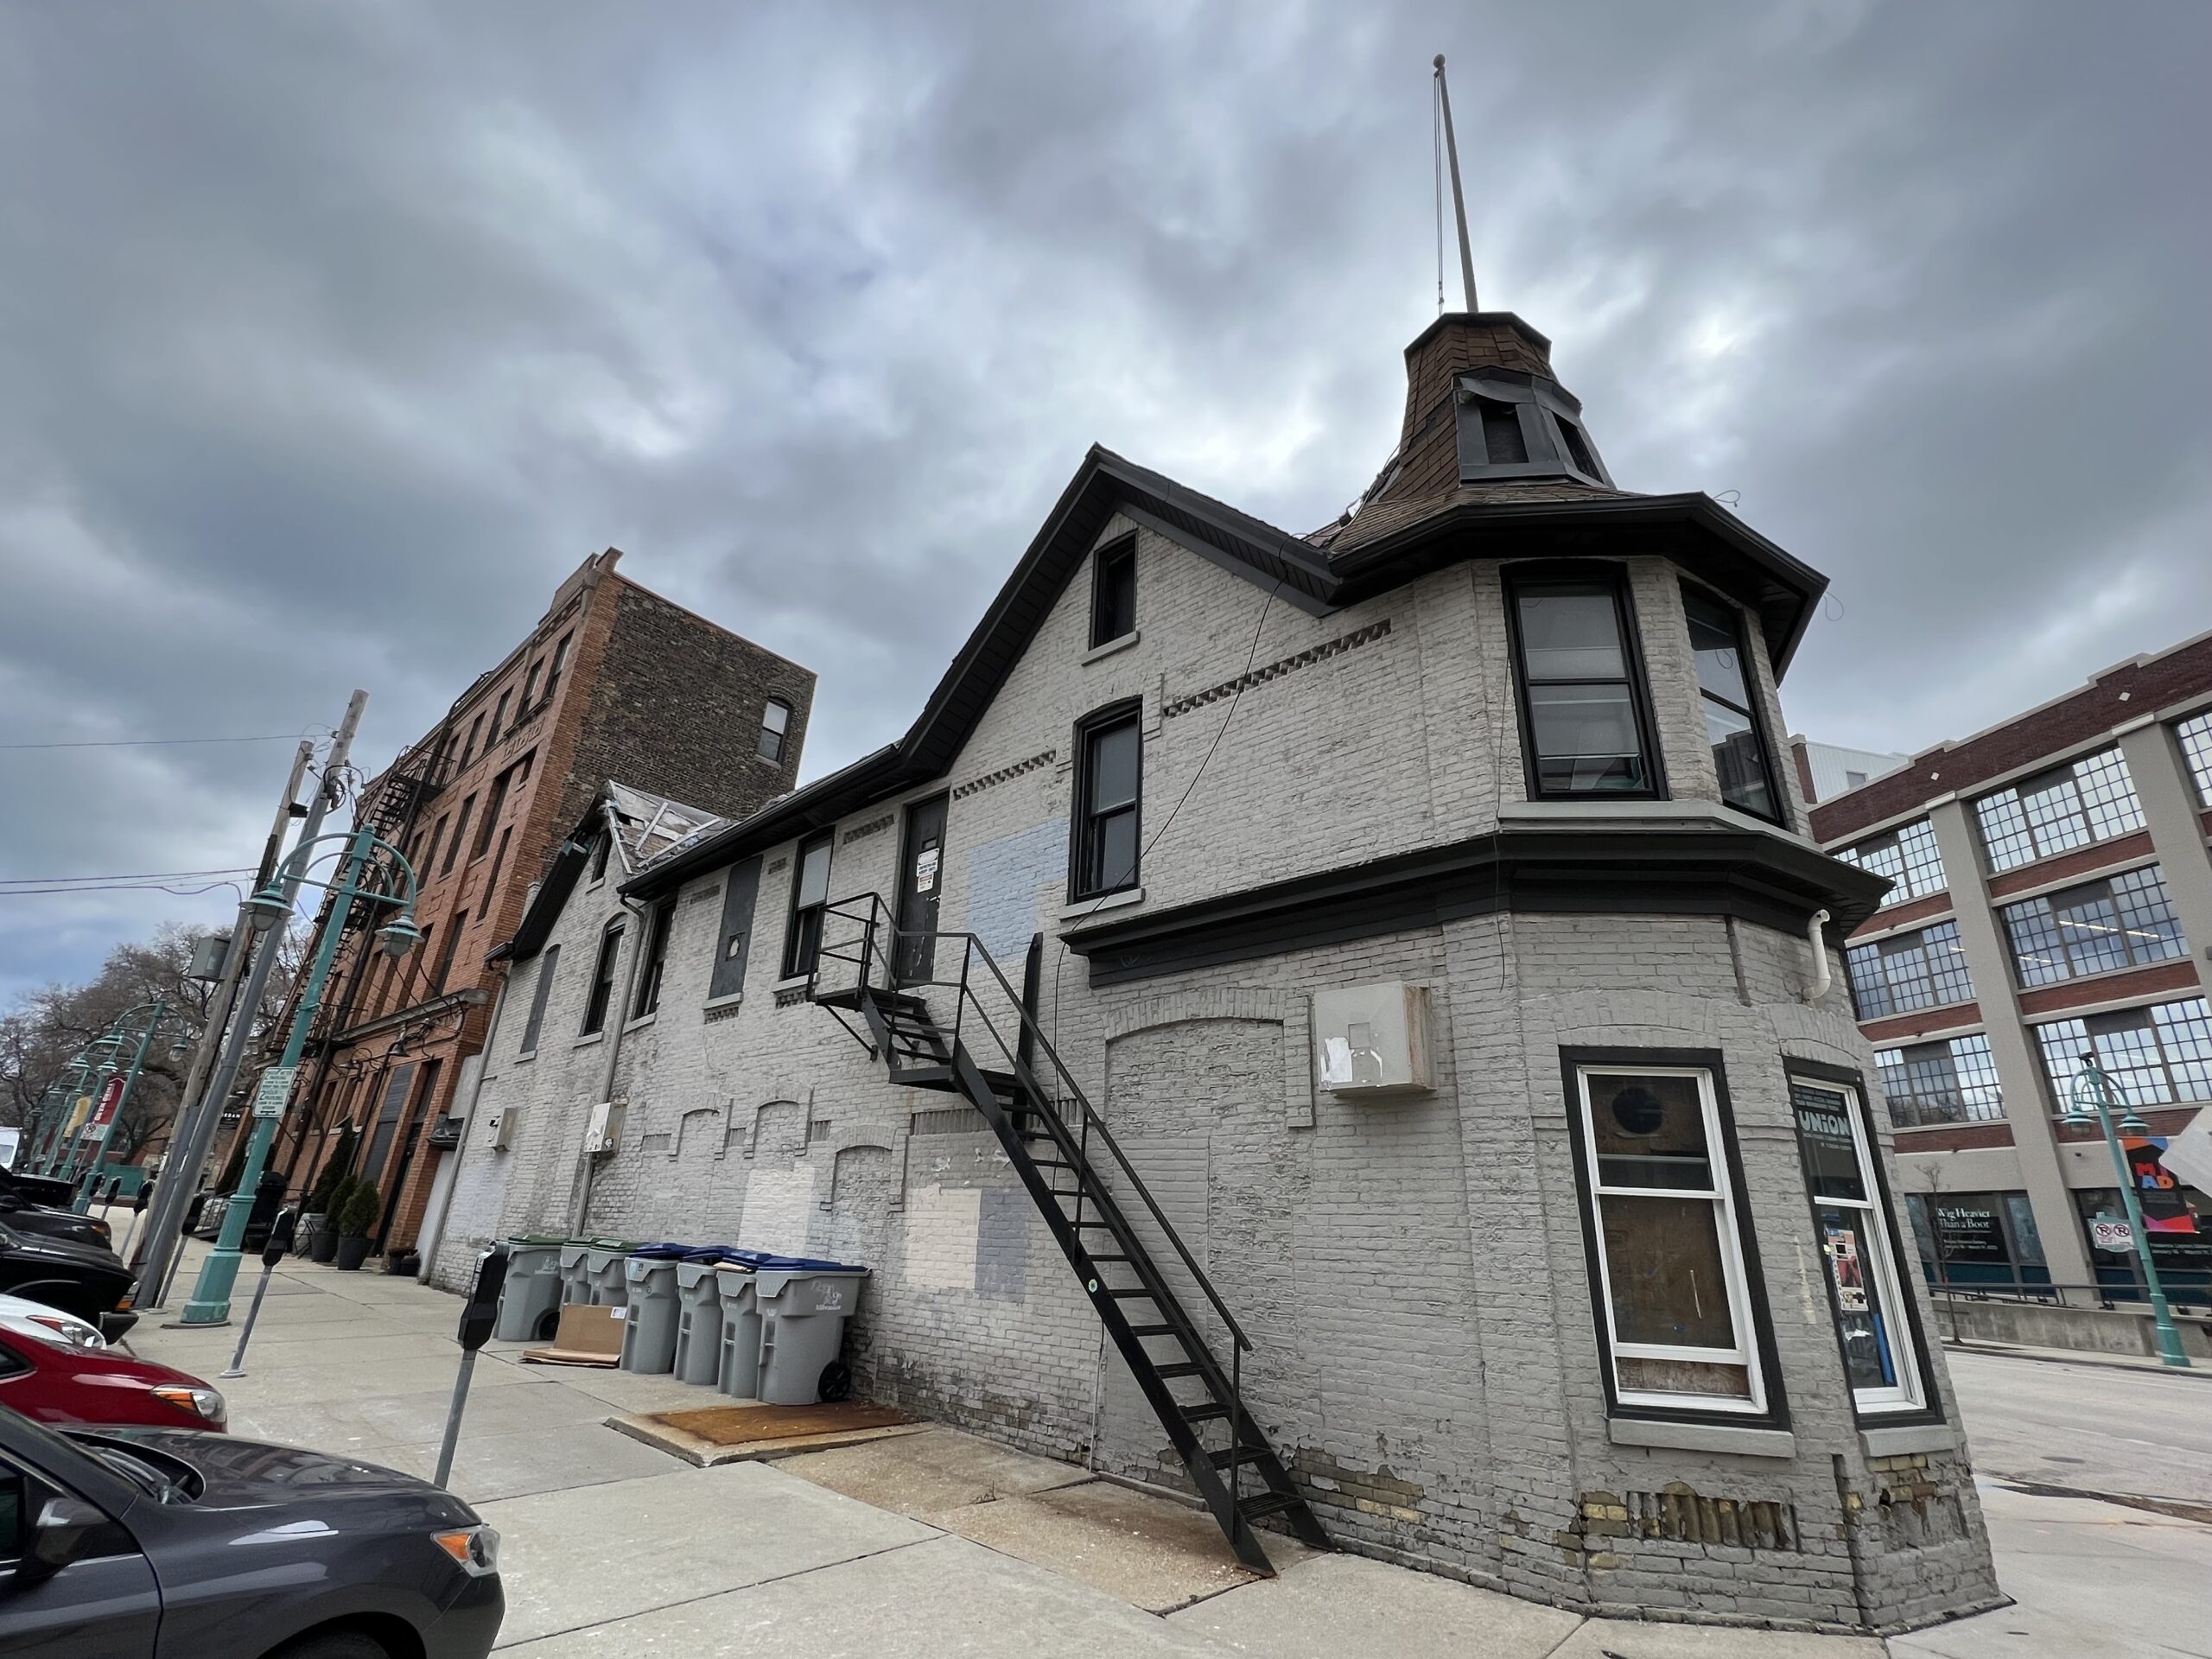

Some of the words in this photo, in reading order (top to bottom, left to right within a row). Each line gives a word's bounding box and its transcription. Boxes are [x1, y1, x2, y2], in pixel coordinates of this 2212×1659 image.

[258, 1090, 266, 1101] 2
[2140, 1174, 2175, 1189] AD
[1955, 1207, 1991, 1217] Heavier
[1967, 1217, 1990, 1229] Boot
